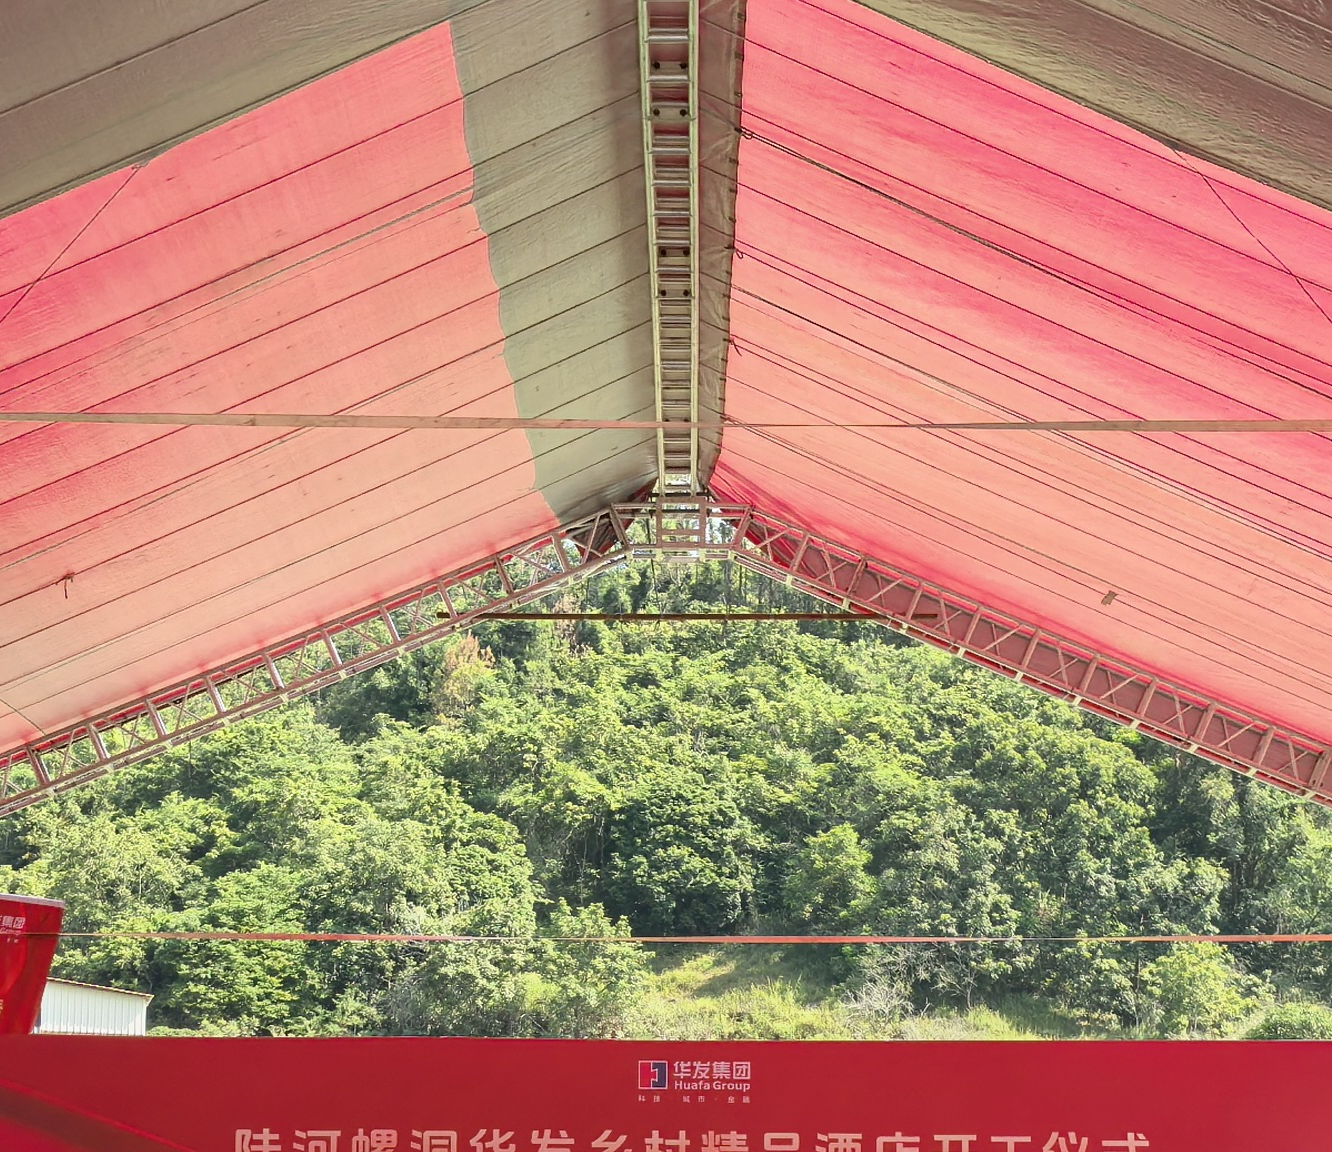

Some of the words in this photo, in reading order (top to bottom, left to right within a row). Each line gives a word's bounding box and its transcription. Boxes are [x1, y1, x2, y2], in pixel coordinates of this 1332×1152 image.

[673, 1061, 751, 1079] 华发集团
[674, 1081, 710, 1090] Huafa
[712, 1081, 751, 1092] Group
